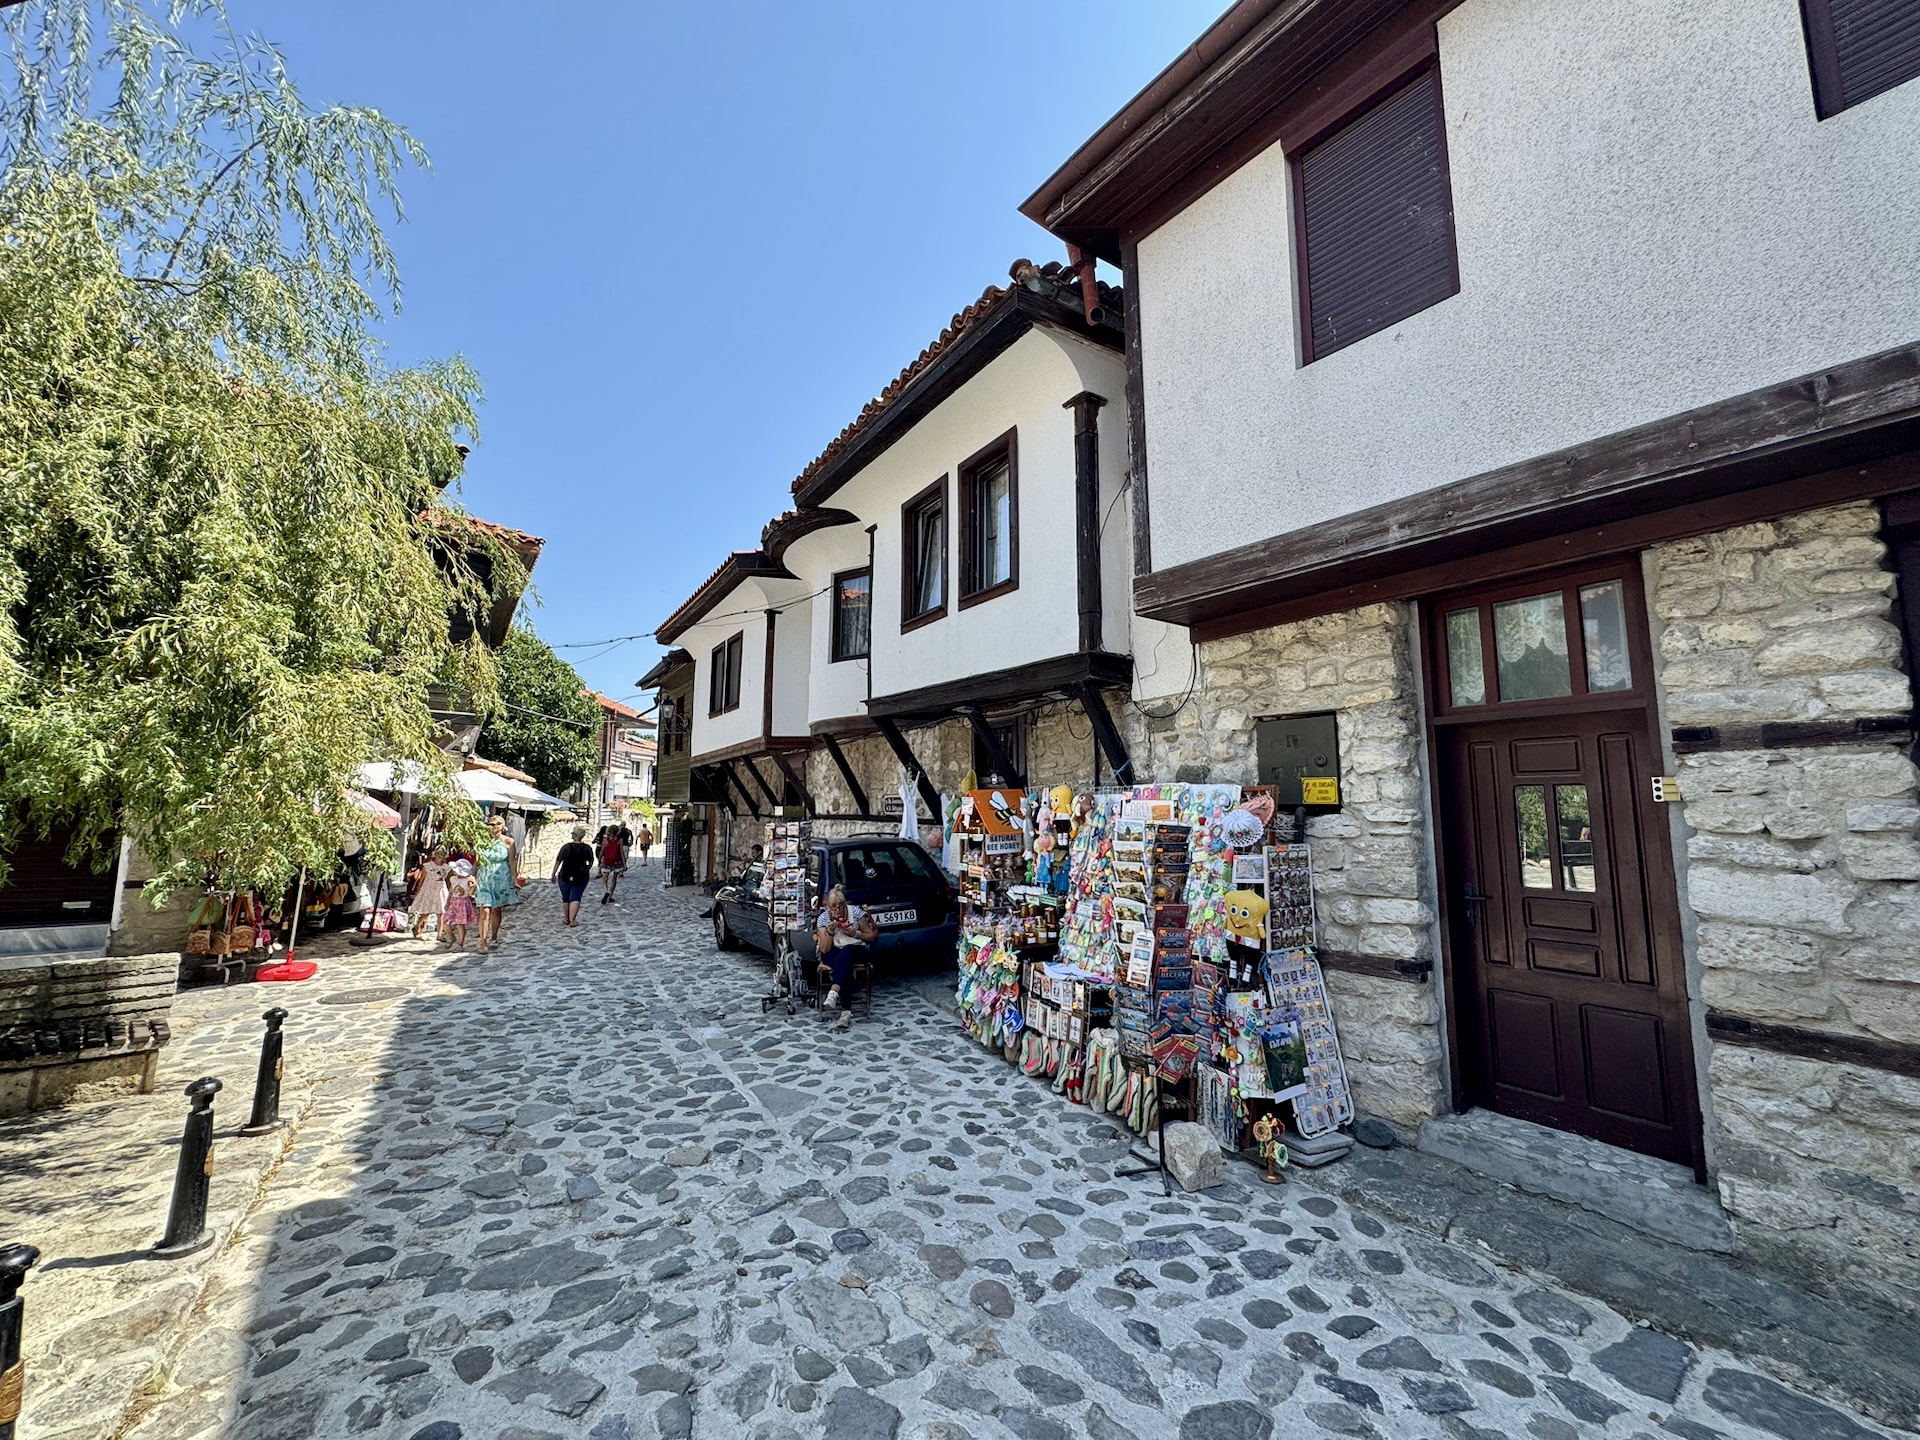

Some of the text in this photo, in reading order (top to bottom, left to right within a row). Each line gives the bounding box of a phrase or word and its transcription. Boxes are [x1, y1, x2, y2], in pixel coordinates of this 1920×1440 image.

[990, 834, 1017, 842] NATURAL
[987, 842, 1020, 851] BEE HONEY
